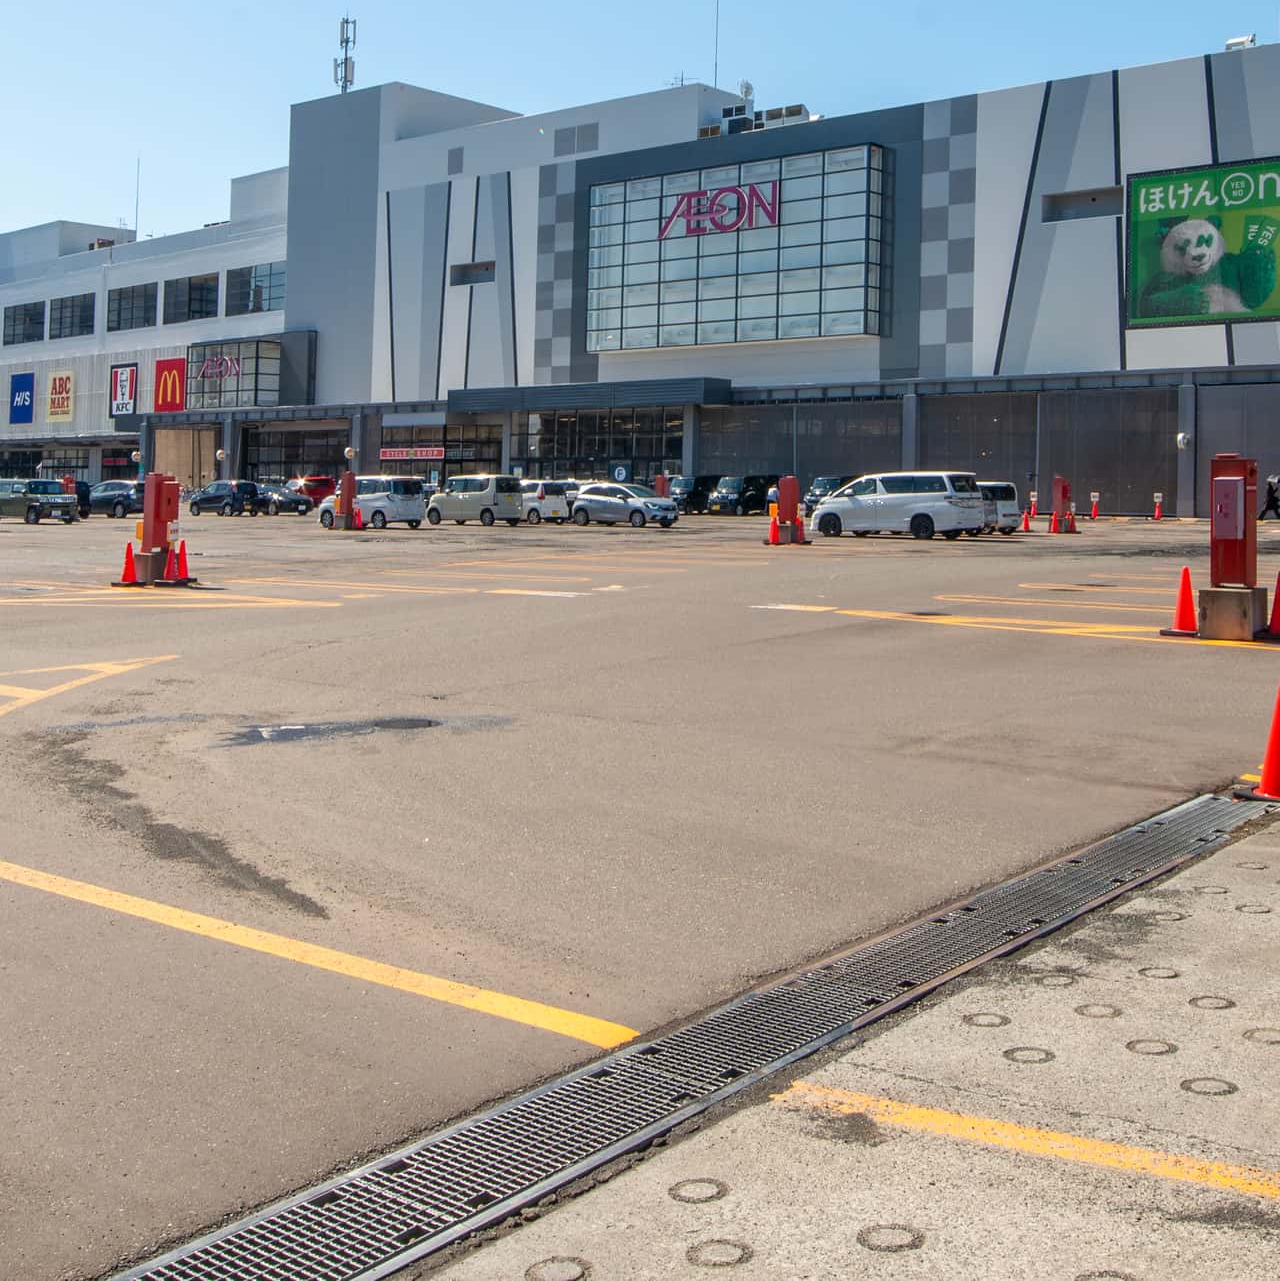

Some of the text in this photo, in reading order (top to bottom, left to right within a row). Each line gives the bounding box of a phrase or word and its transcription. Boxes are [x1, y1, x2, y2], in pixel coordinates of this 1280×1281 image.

[1230, 180, 1246, 189] YES
[1139, 180, 1219, 214] ほけん
[1232, 189, 1244, 198] NO
[51, 376, 71, 396] ABC
[50, 396, 70, 410] MART
[115, 401, 130, 413] KFC
